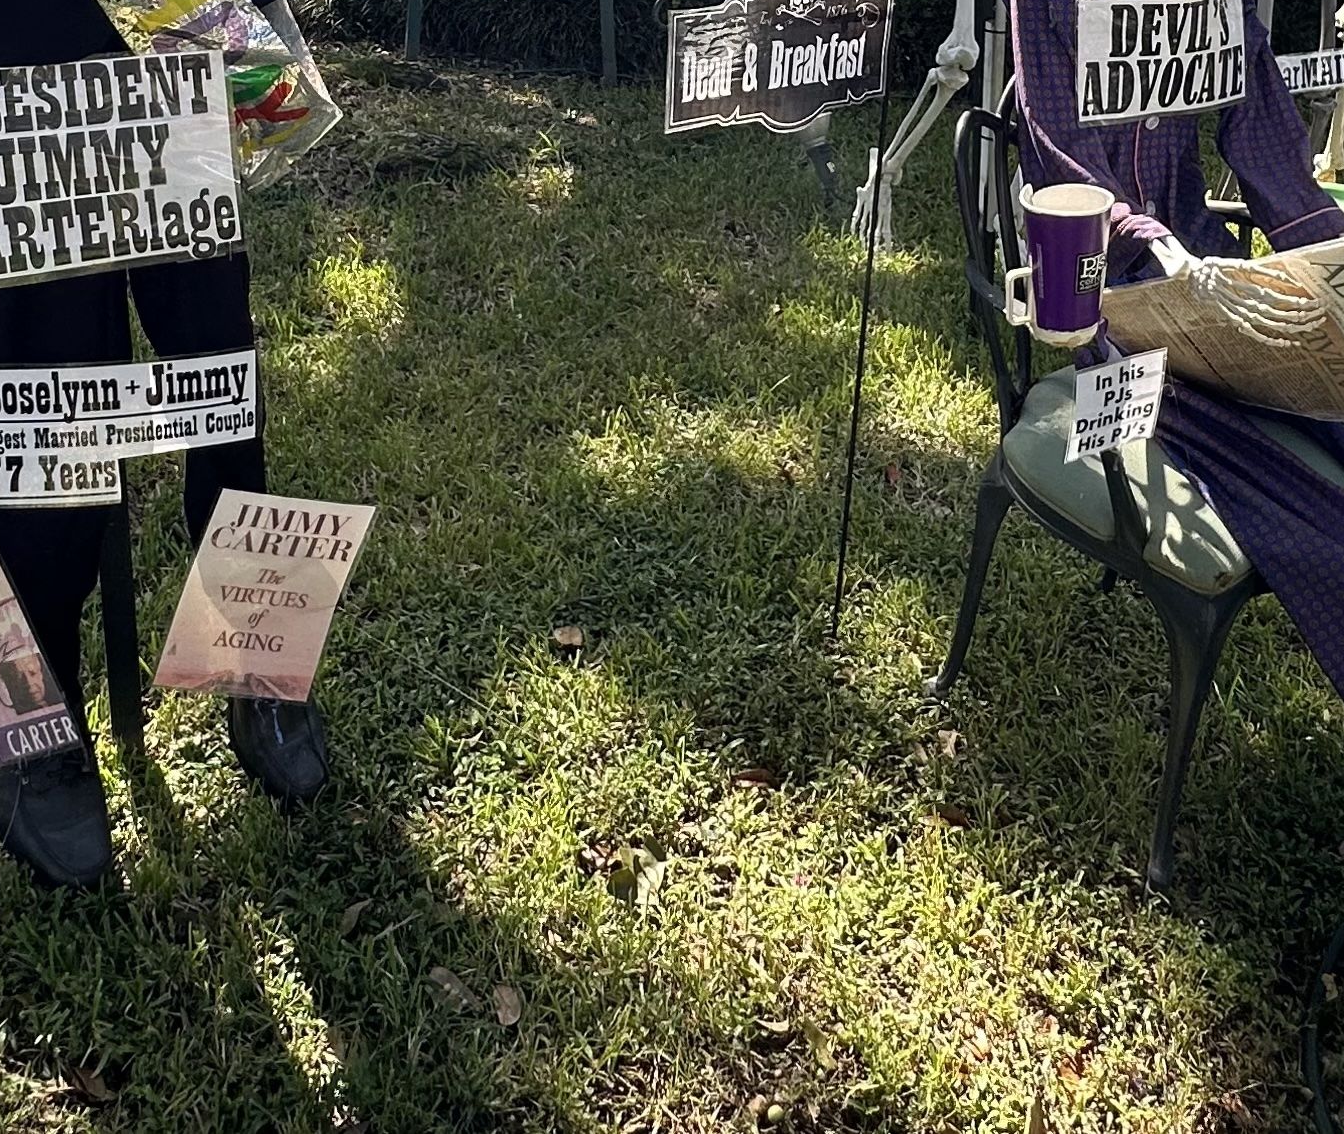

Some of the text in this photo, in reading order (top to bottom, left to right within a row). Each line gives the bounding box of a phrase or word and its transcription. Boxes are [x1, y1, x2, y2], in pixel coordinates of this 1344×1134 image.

[681, 31, 867, 103] Dead & Breakfast
[1082, 45, 1243, 116] ADVOCATE
[125, 380, 140, 395] +
[146, 363, 248, 405] Jimmy
[1096, 364, 1144, 391] In his
[1103, 387, 1132, 407] PJs
[34, 427, 98, 449] Married
[105, 415, 197, 445] Presidential
[205, 408, 255, 435] Couple
[1076, 402, 1154, 434] Drinking
[1078, 421, 1146, 452] His PJ's
[38, 455, 117, 492] Years
[231, 503, 352, 536] JIMMY
[211, 525, 353, 563] CARTER
[256, 568, 286, 585] The
[220, 585, 309, 609] VIRTUES
[247, 609, 270, 627] of
[213, 630, 284, 653] AGING
[7, 716, 79, 756] CARTER
